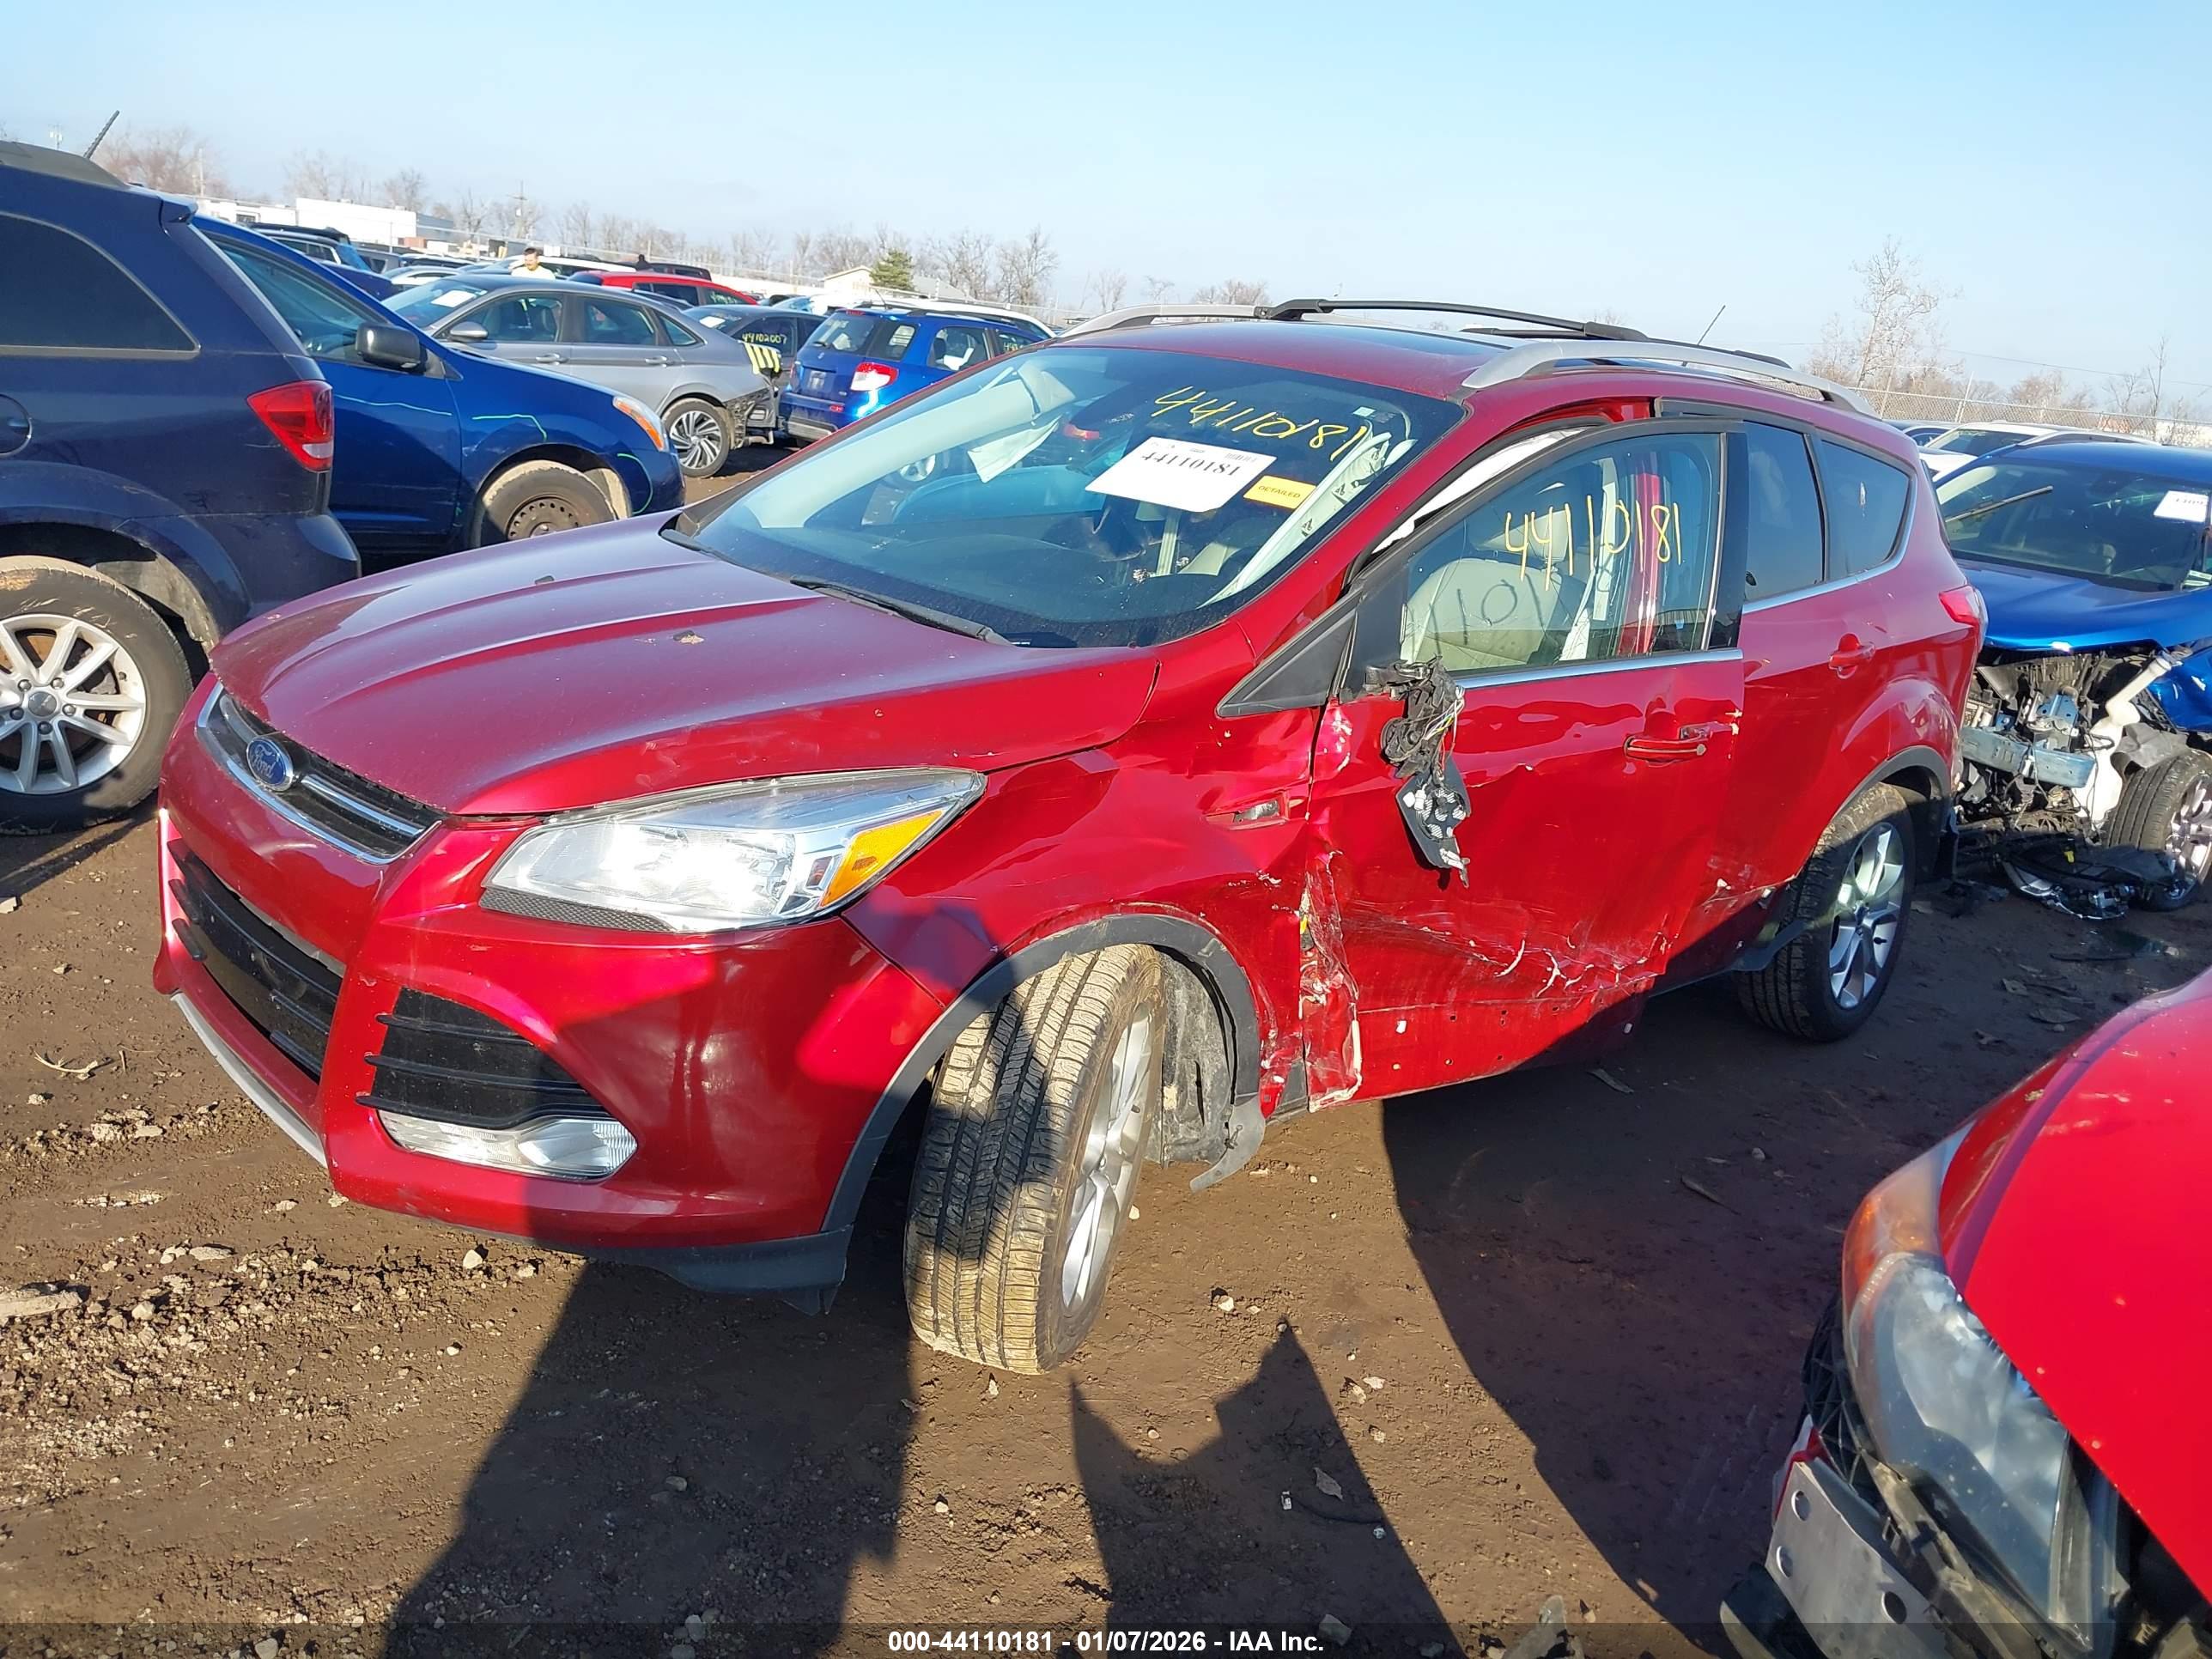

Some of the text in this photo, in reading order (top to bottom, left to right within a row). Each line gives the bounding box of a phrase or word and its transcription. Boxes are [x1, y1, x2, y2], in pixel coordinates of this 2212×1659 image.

[1151, 386, 1368, 462] 44110181
[1141, 452, 1241, 476] 44110181
[1258, 485, 1301, 499] DETAILED
[1504, 495, 1681, 592] 44110181
